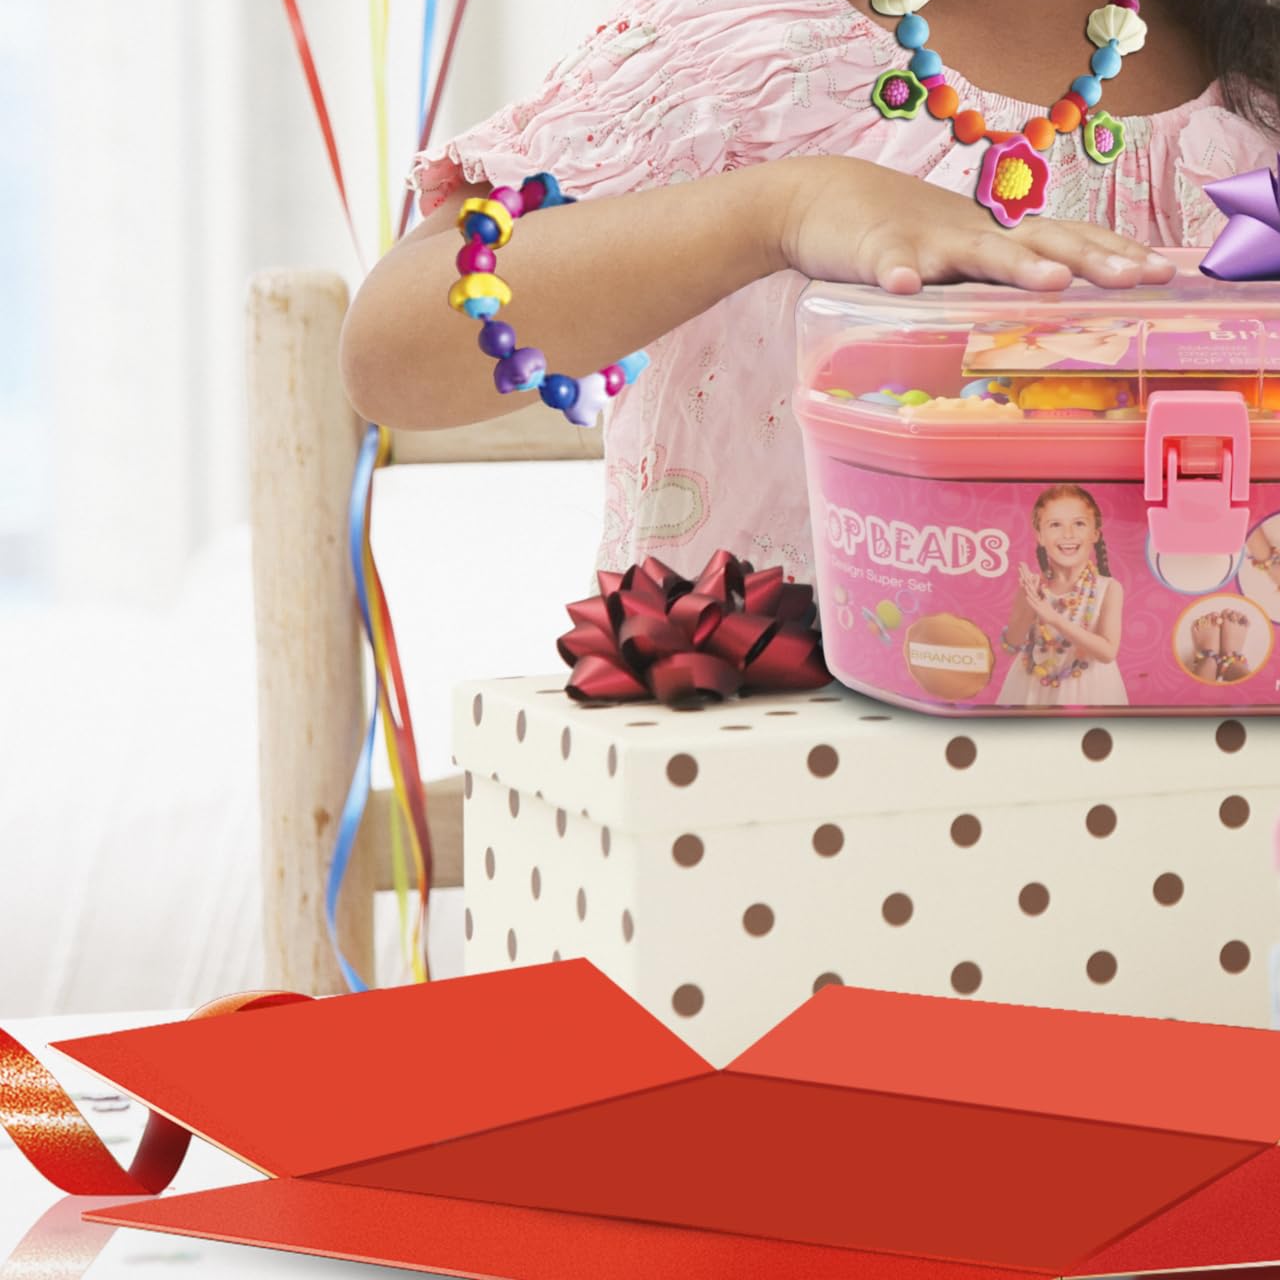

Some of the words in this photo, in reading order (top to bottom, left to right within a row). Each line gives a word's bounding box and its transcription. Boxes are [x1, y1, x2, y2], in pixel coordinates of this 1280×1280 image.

[864, 516, 1010, 578] BEADS
[866, 567, 904, 589] Super
[907, 578, 933, 593] Set
